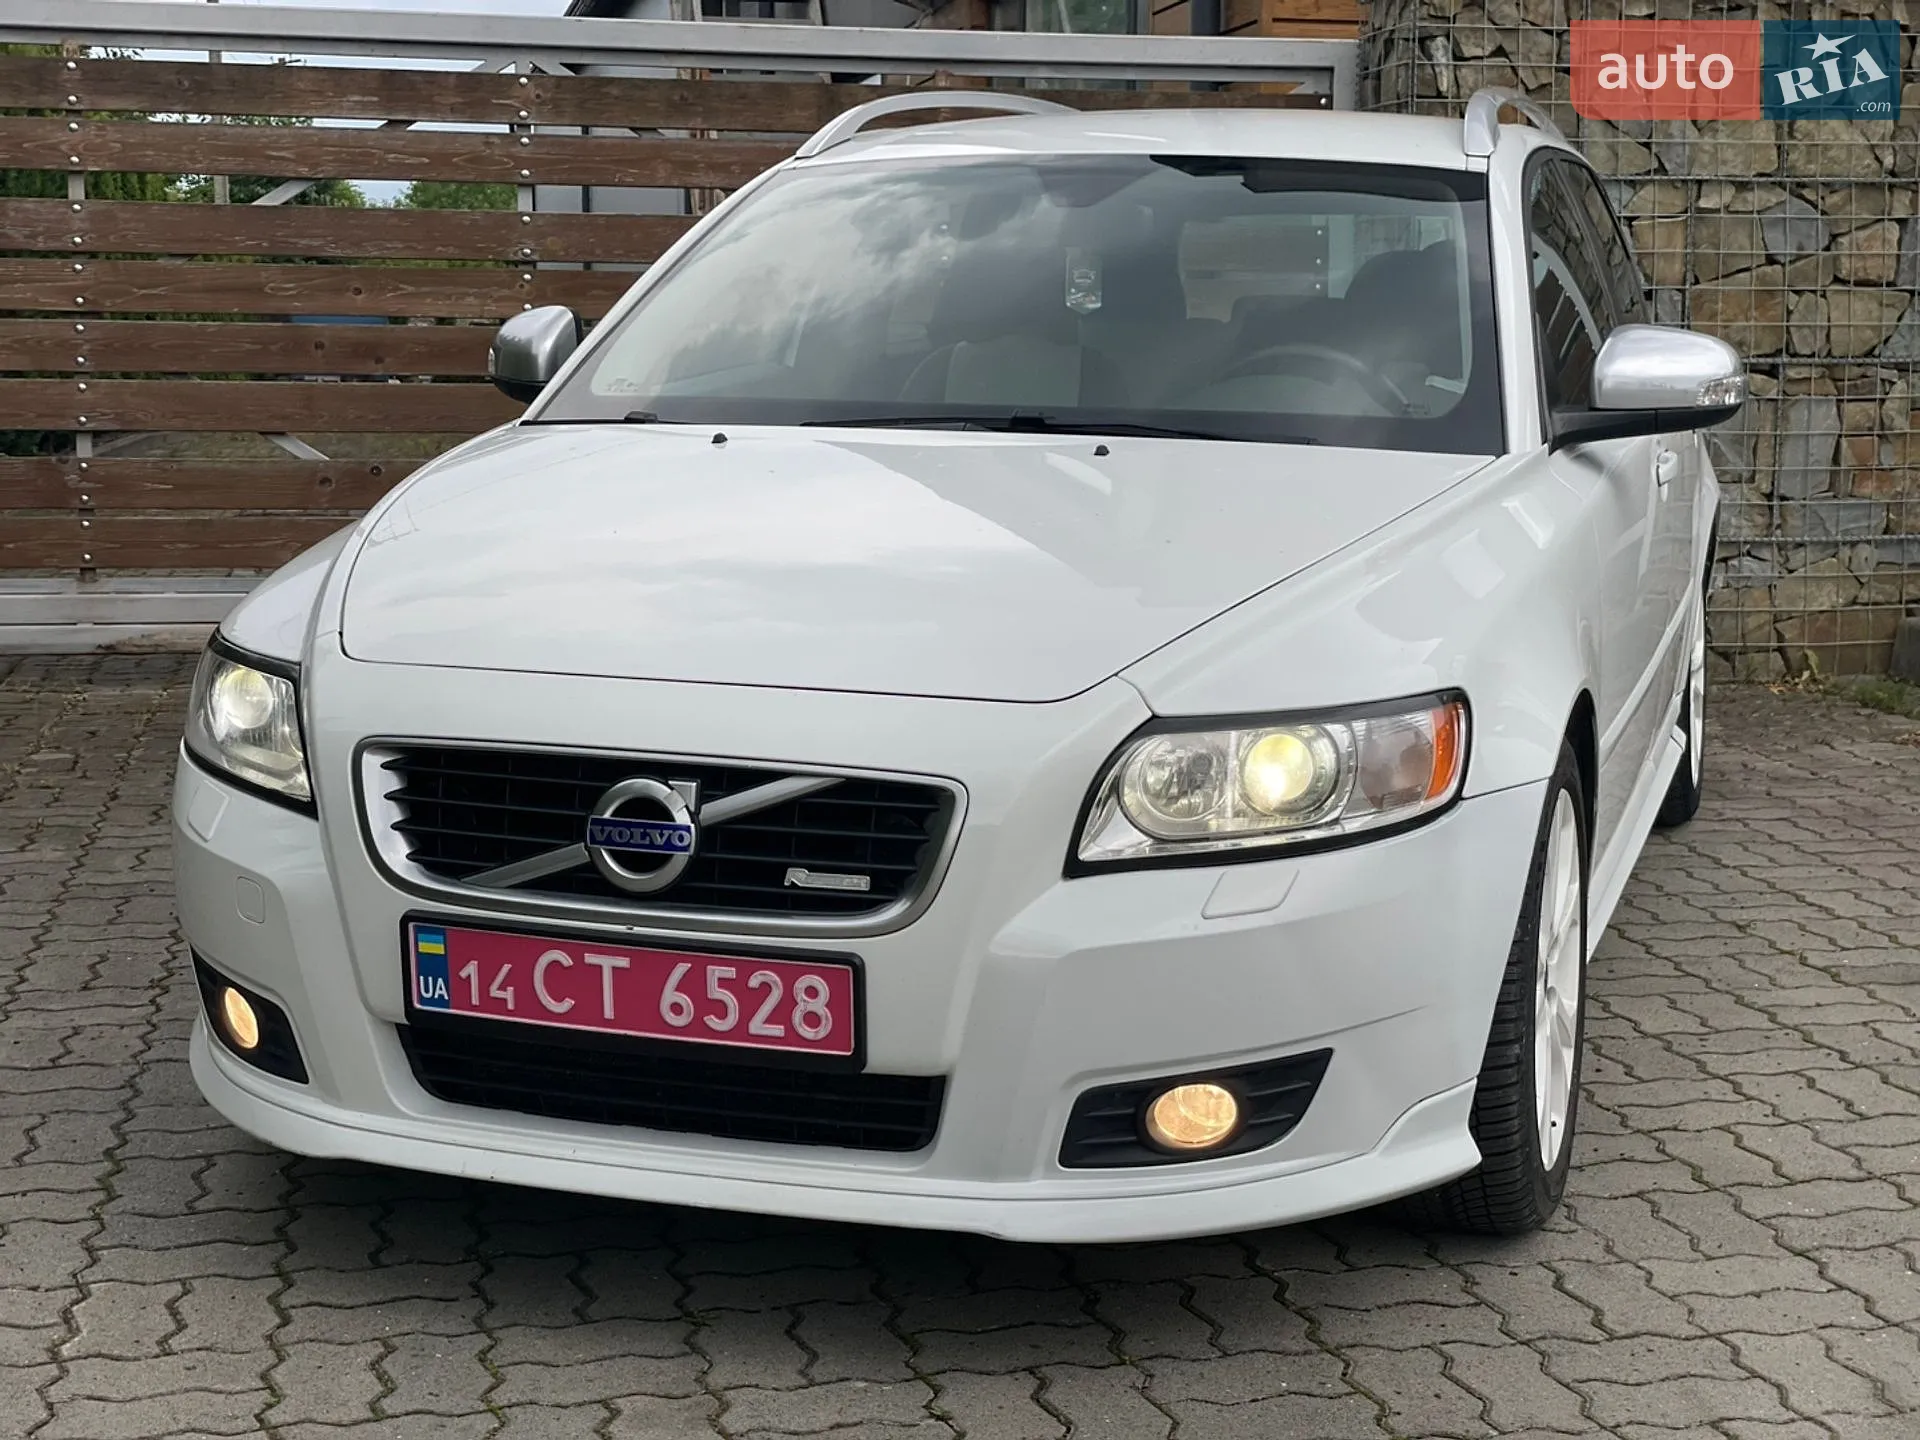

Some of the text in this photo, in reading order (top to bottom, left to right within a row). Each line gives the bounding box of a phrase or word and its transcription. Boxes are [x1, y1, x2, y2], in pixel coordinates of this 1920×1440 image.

[590, 824, 691, 847] VOLVO
[419, 975, 449, 1000] UA
[458, 949, 833, 1041] 14 CT 6528
